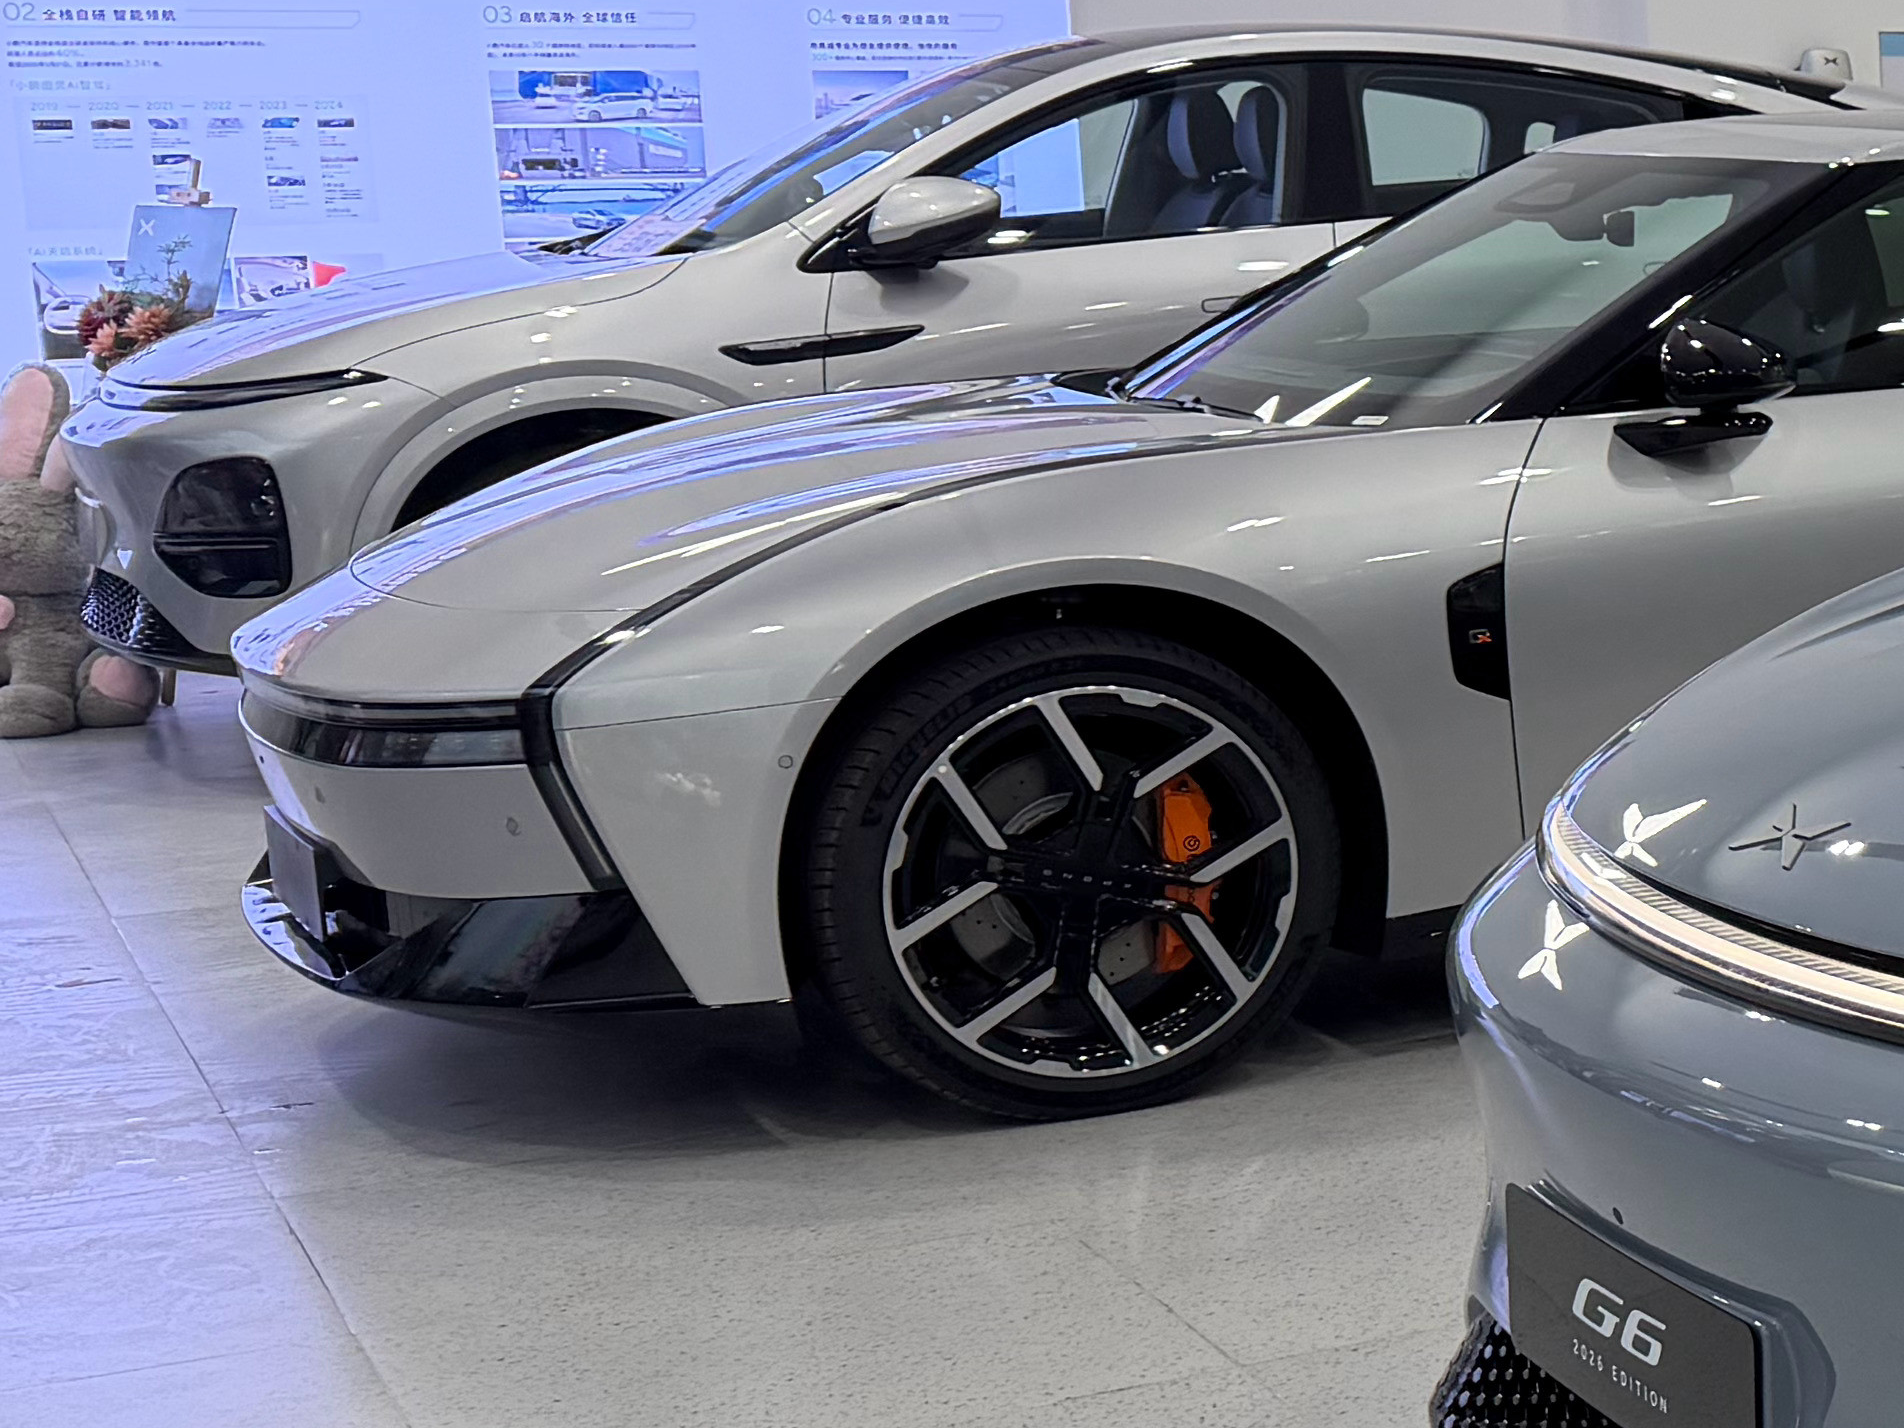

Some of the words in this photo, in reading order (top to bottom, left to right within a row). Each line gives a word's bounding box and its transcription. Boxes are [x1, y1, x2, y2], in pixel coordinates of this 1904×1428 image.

[3, 2, 36, 21] 02
[483, 6, 512, 23] 03
[519, 12, 575, 23] 启航海外
[582, 12, 637, 23] 全球信任
[807, 8, 836, 25] 04
[88, 102, 119, 111] 2020
[146, 101, 174, 110] 2021
[203, 101, 232, 110] 2022
[259, 101, 287, 110] 2023
[1572, 1278, 1666, 1366] G6
[1573, 1338, 1604, 1372] 2026
[1612, 1365, 1667, 1413] EDITION
